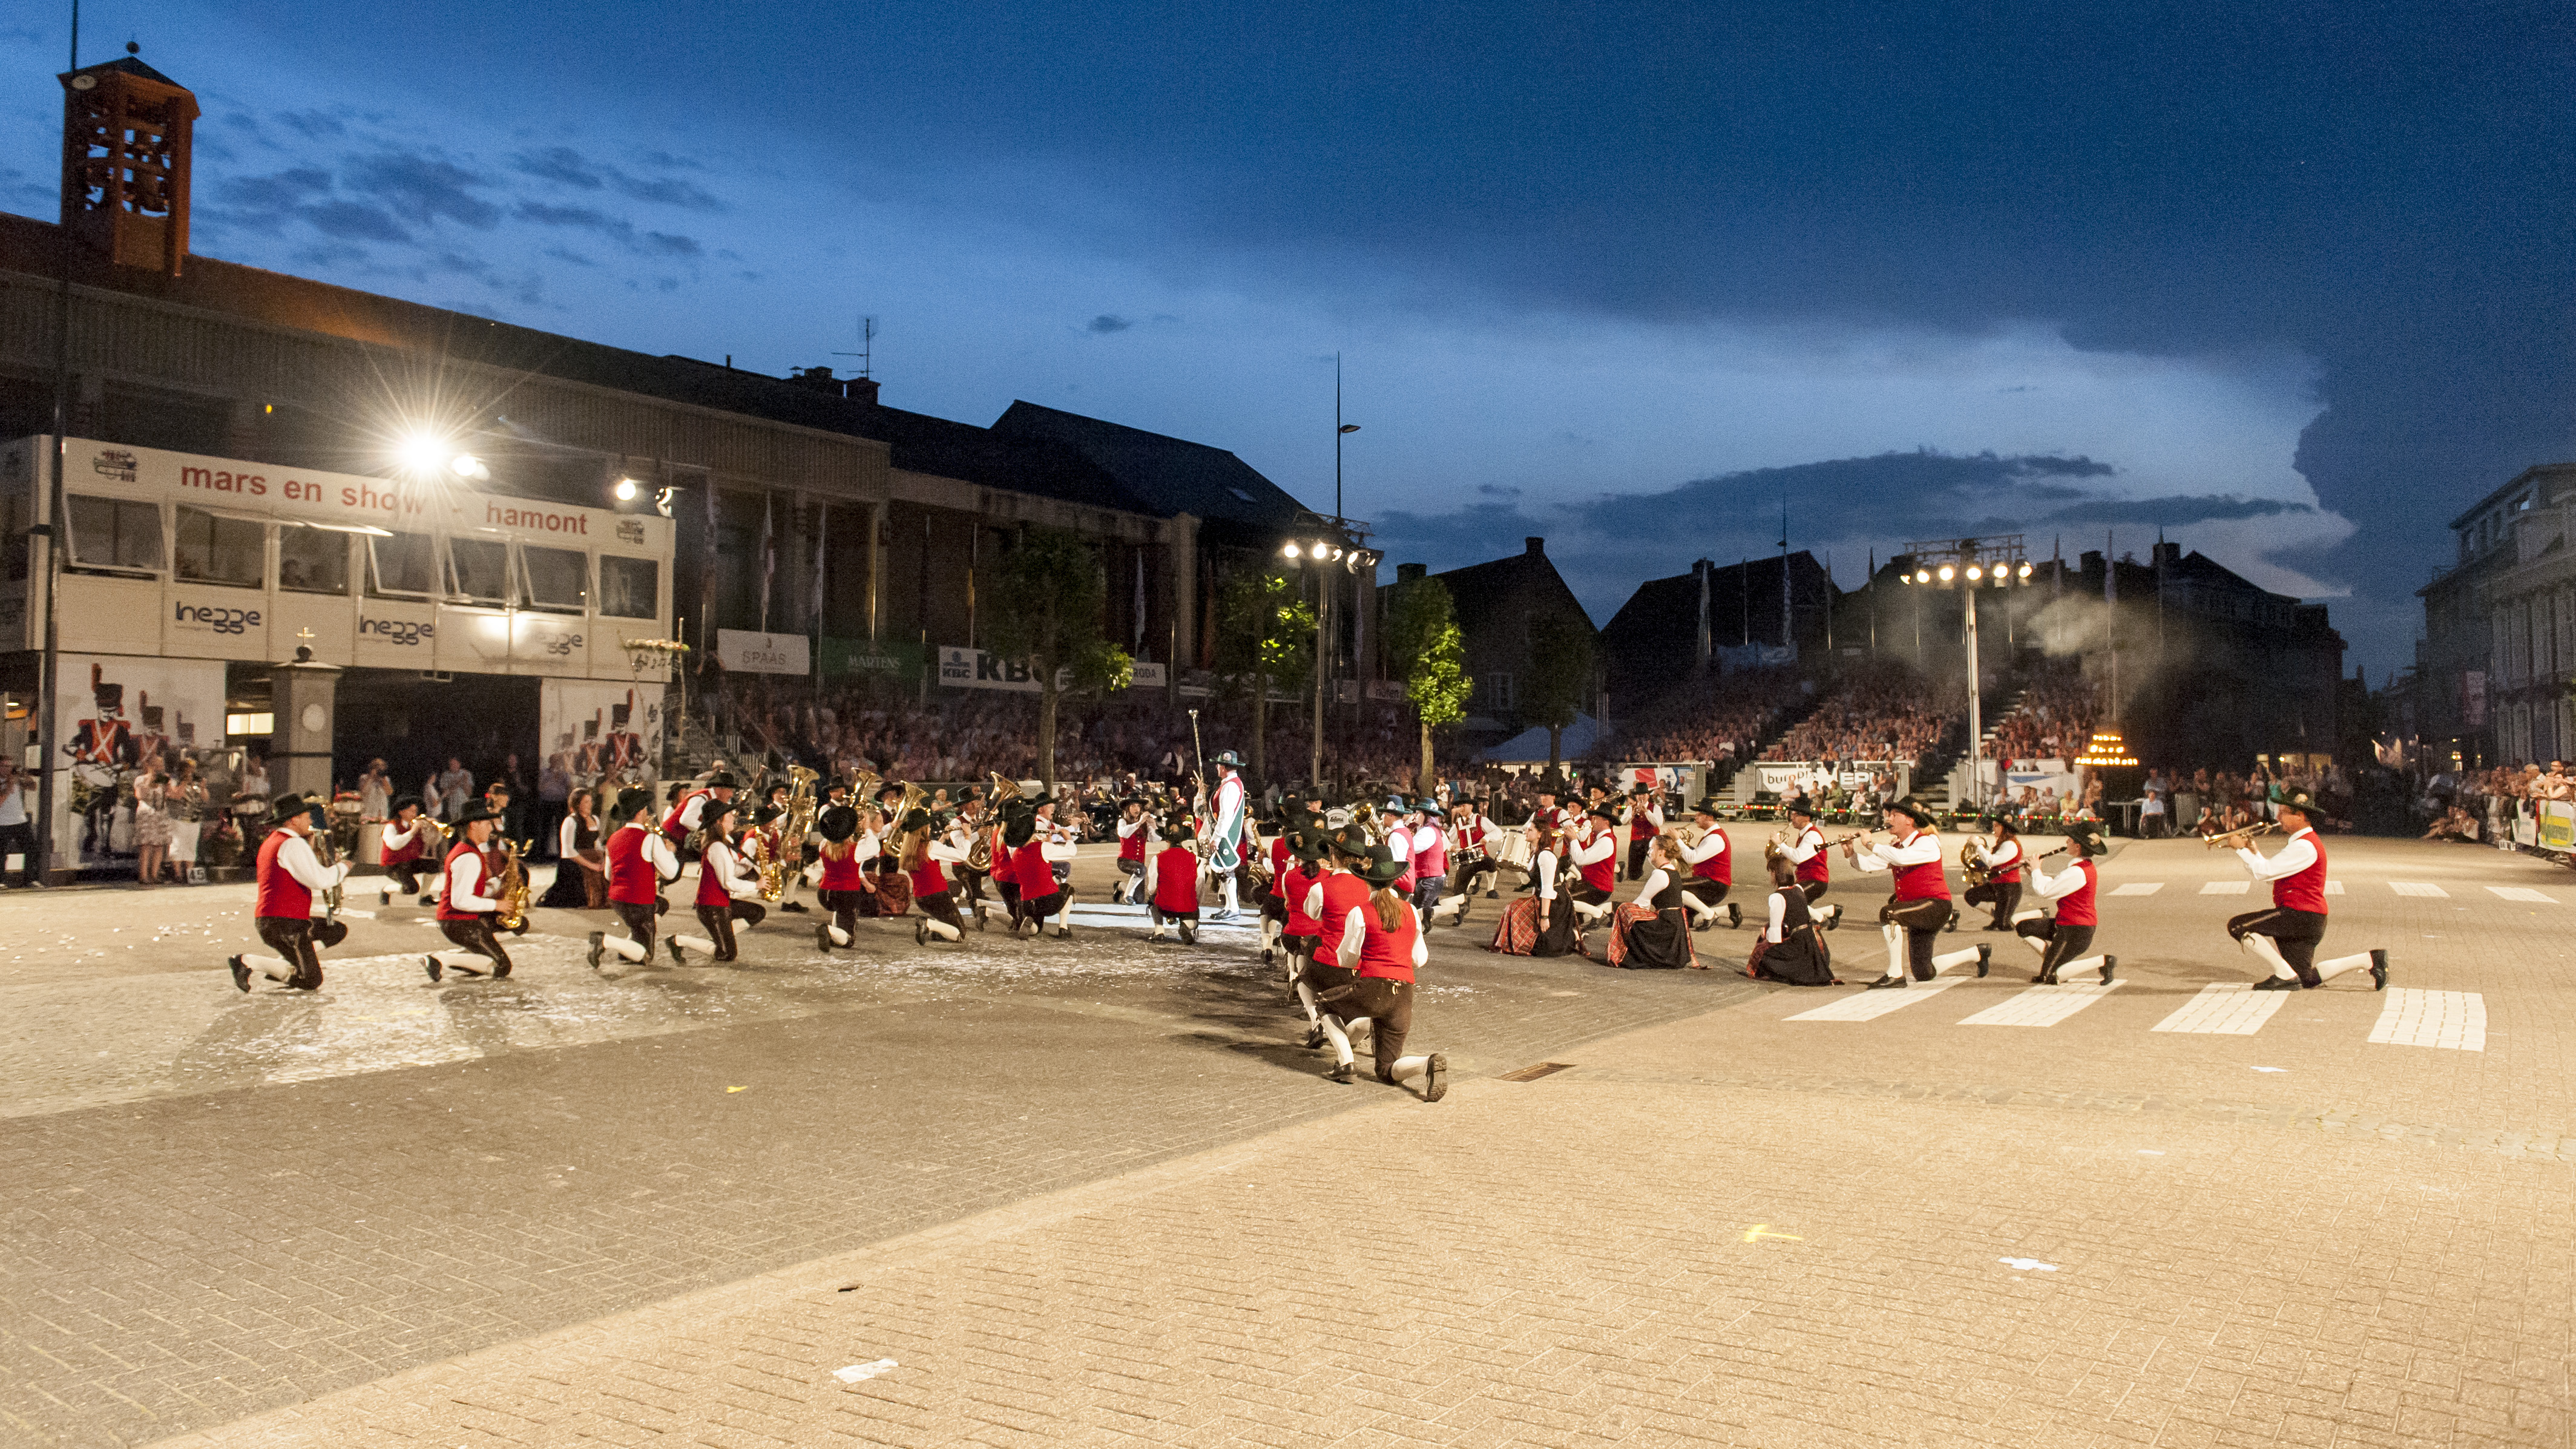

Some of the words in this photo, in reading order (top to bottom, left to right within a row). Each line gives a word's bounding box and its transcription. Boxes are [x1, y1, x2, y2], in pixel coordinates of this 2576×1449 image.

[182, 466, 266, 495] mars
[284, 480, 321, 502] en
[341, 484, 422, 514] show
[486, 502, 588, 534] hamont
[743, 651, 786, 665] SPAAS
[848, 656, 901, 669] MARTENS
[942, 668, 971, 678] KBC
[977, 653, 1043, 683] KB
